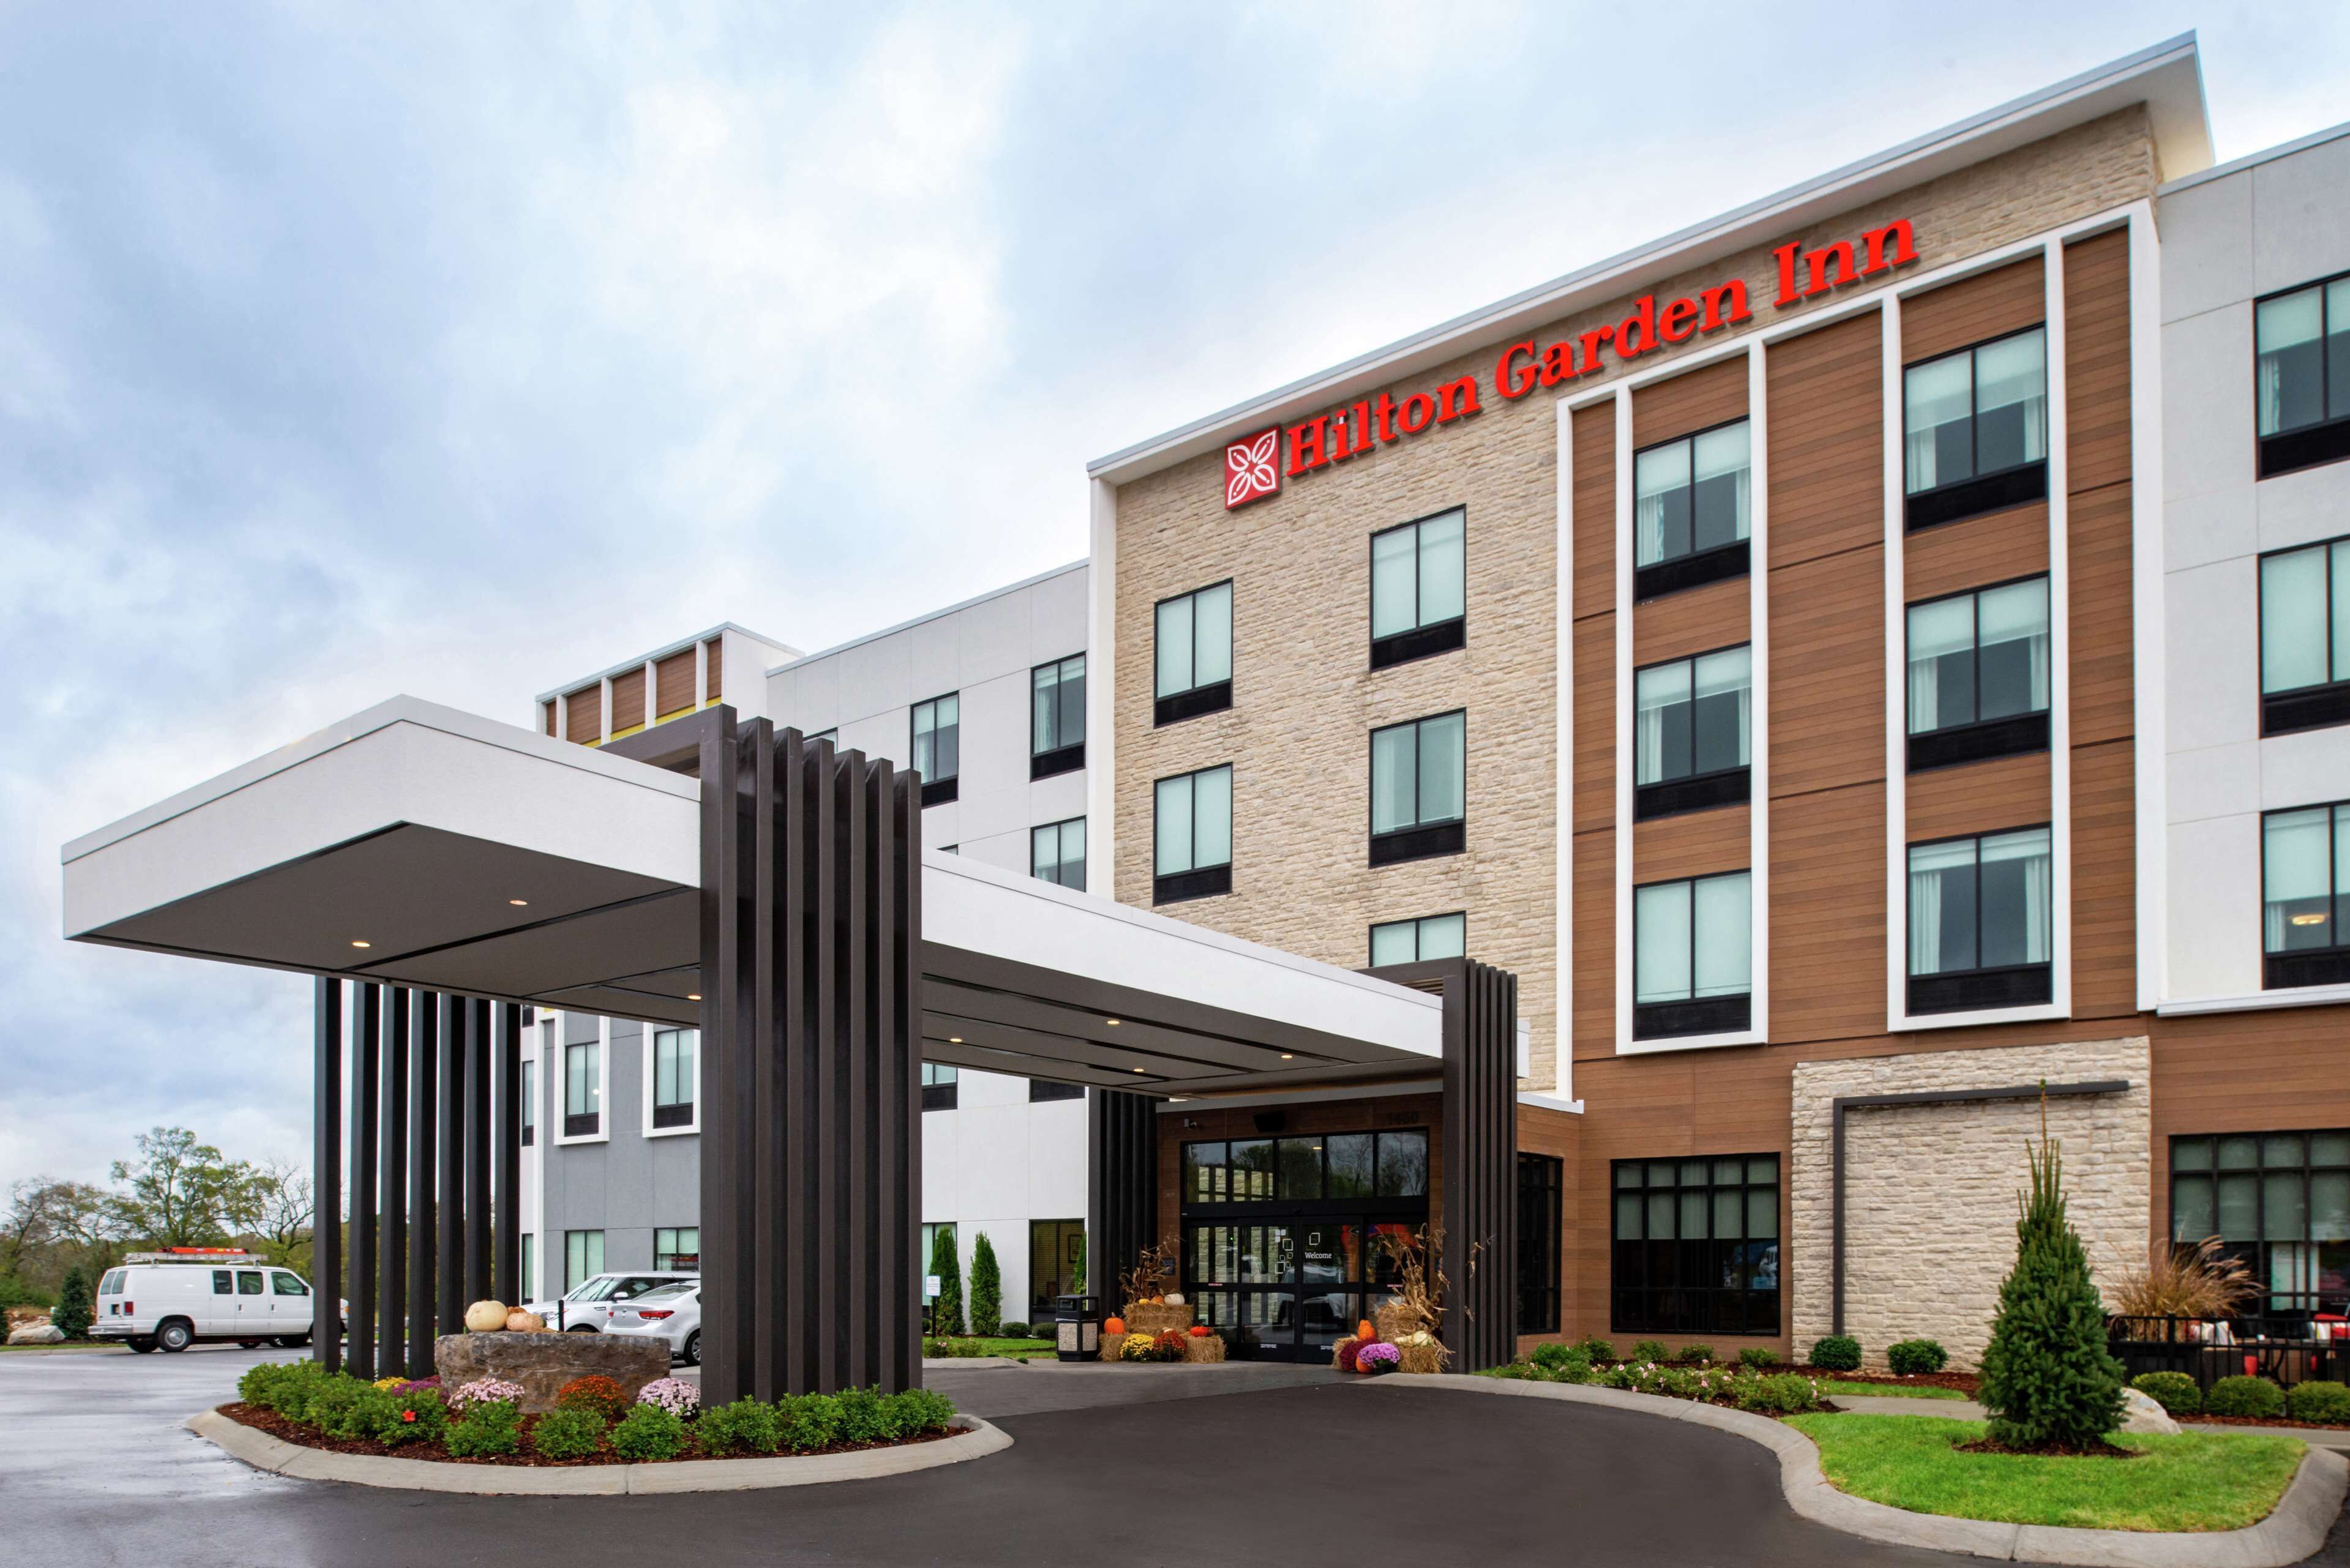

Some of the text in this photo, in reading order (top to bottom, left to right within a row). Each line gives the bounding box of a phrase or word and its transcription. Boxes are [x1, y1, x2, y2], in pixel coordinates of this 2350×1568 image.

[1285, 218, 1920, 479] Hilton Garden Inn
